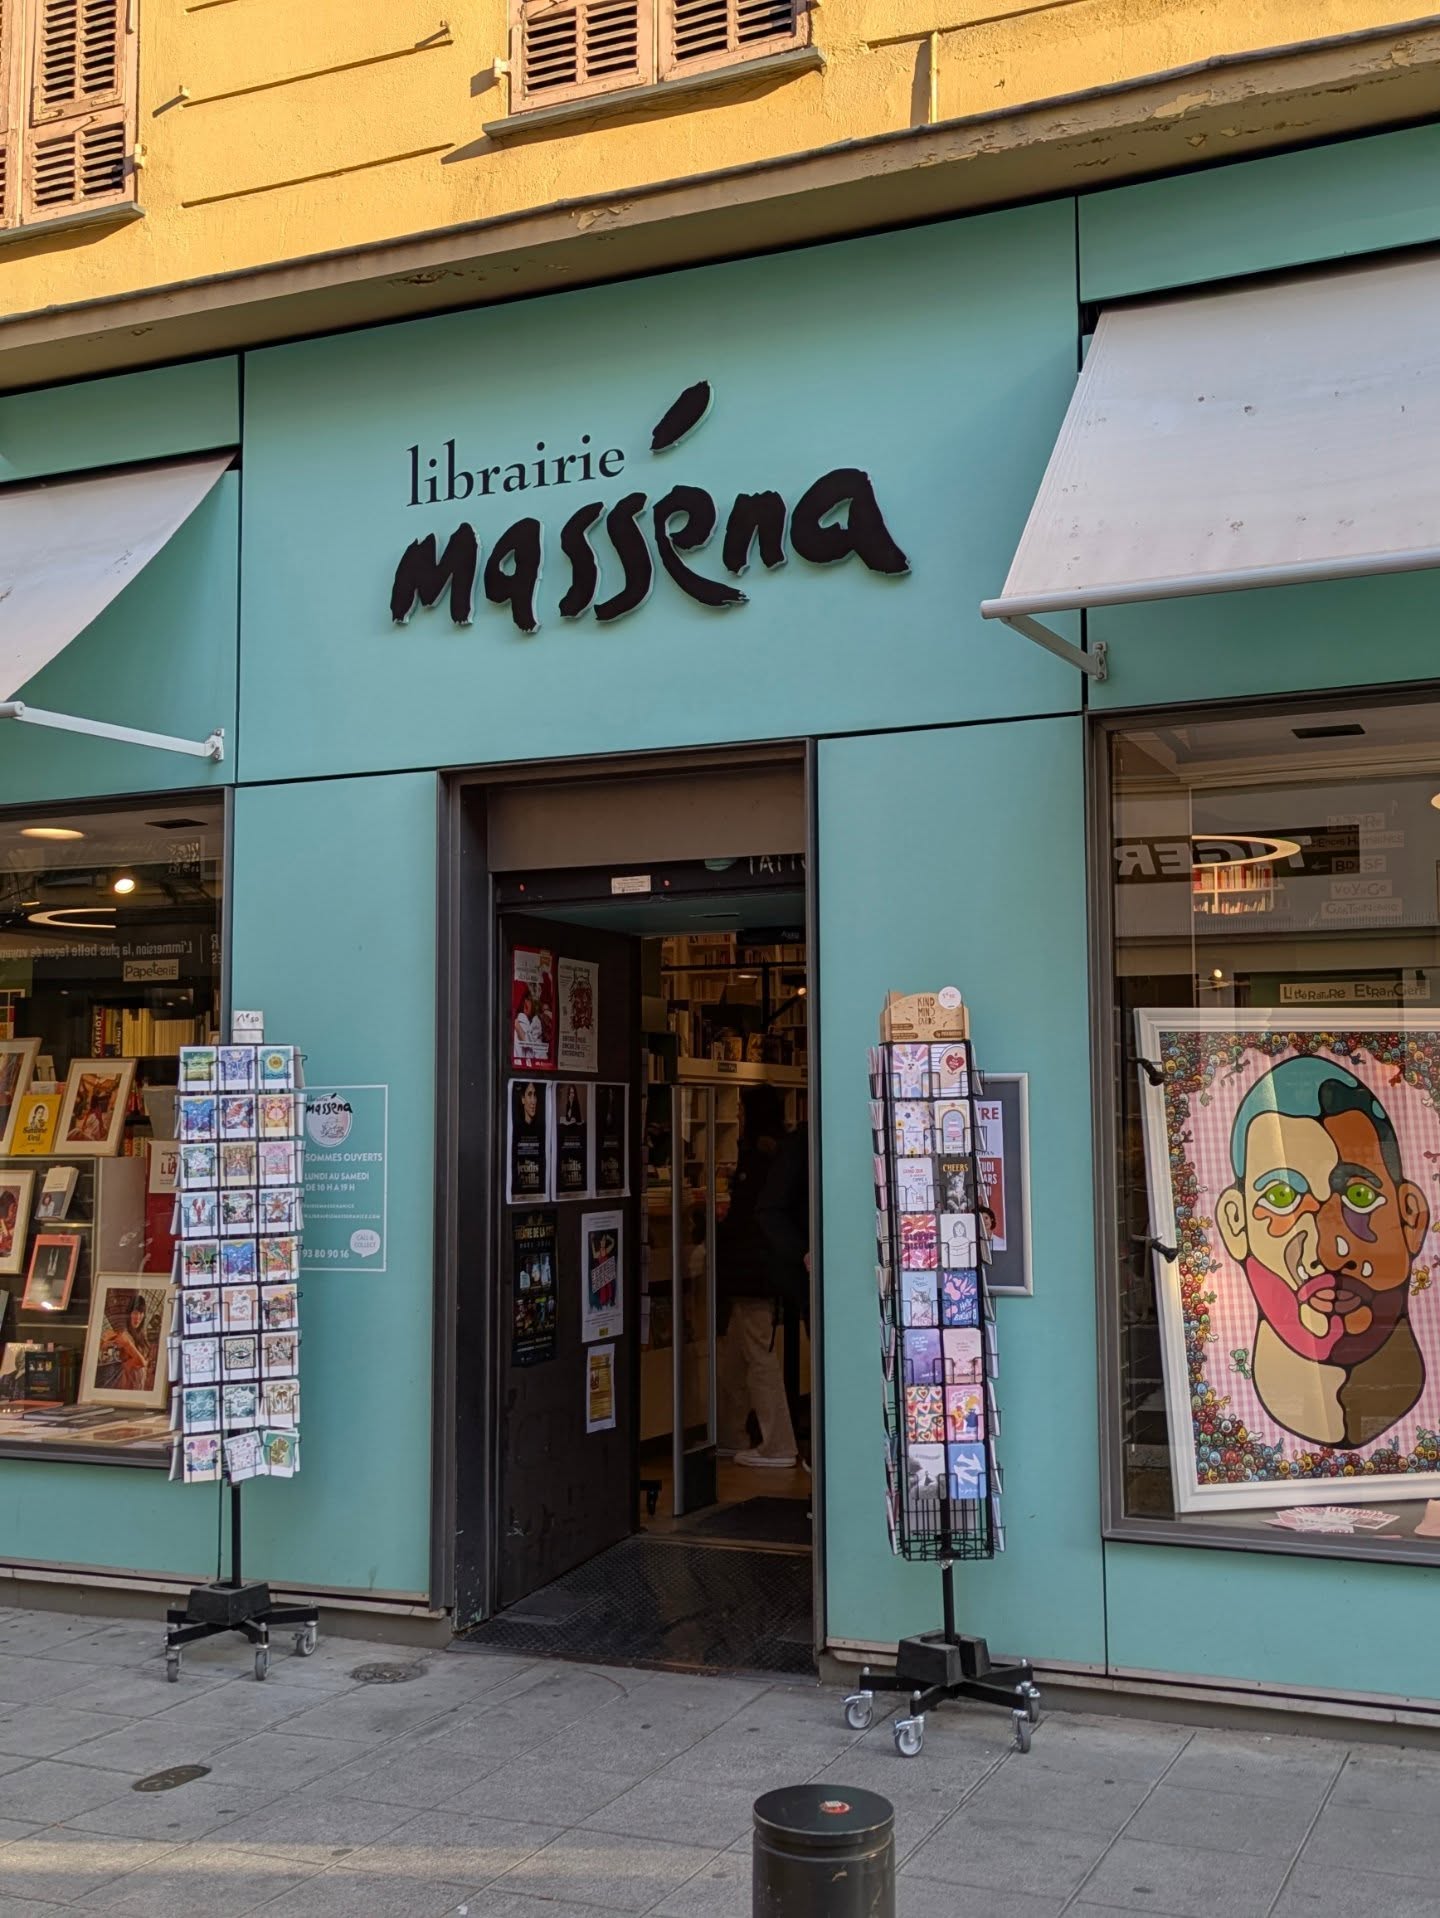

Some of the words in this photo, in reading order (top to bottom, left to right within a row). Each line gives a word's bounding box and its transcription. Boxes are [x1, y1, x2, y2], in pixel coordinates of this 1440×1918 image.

[406, 434, 625, 507] librairie
[391, 380, 911, 632] masséna
[917, 996, 935, 1007] KIND
[305, 1153, 342, 1162] SOMMES
[343, 1152, 383, 1162] OUVERTS
[942, 1163, 969, 1173] CHEERS
[304, 1172, 328, 1181] LUNDI
[329, 1172, 340, 1181] AU
[341, 1172, 370, 1181] SAMEDI
[305, 1184, 316, 1192] DE
[348, 1184, 355, 1192] H
[303, 1250, 313, 1258] 93
[314, 1249, 326, 1258] 80
[327, 1249, 339, 1258] 90
[340, 1249, 350, 1258] 16
